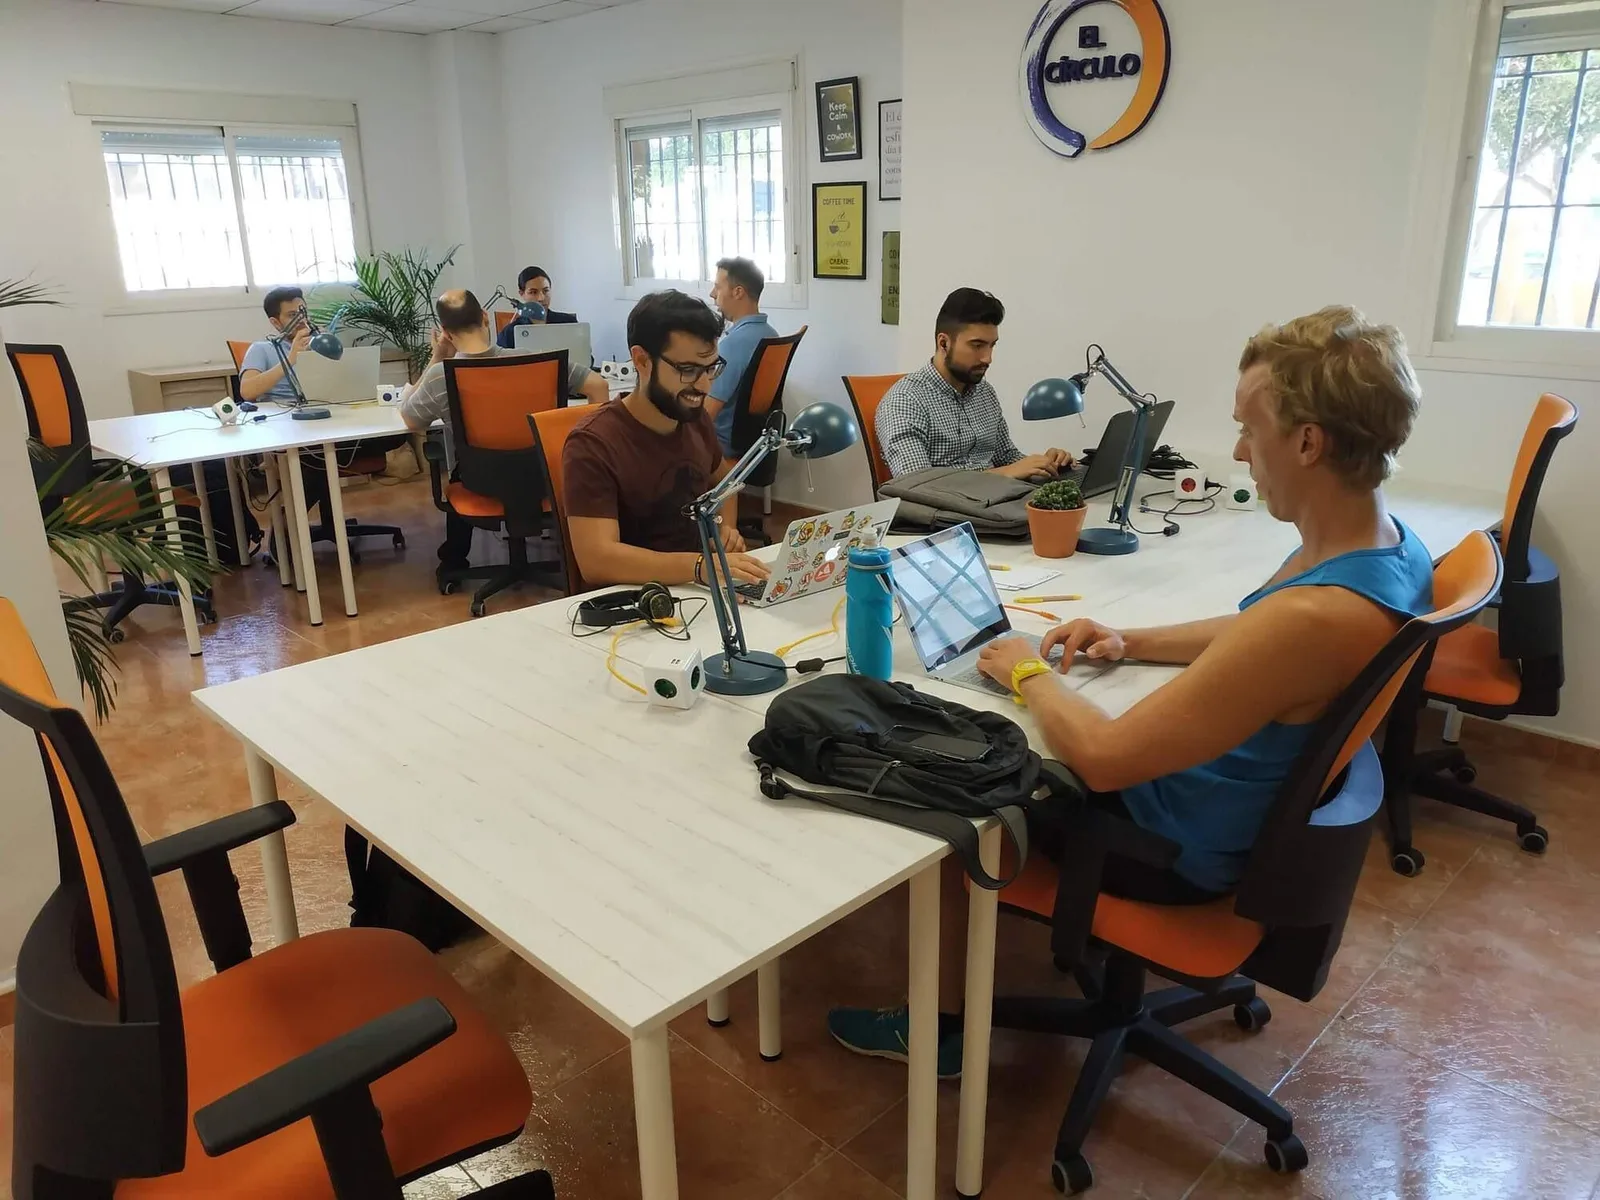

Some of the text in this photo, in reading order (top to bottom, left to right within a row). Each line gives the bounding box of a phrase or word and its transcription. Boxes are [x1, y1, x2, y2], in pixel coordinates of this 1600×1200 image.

[1078, 25, 1107, 49] EL
[1044, 53, 1141, 83] CÍRCULO
[828, 102, 847, 112] Keep
[828, 111, 848, 121] Calm
[822, 197, 856, 206] COFFEE TIME
